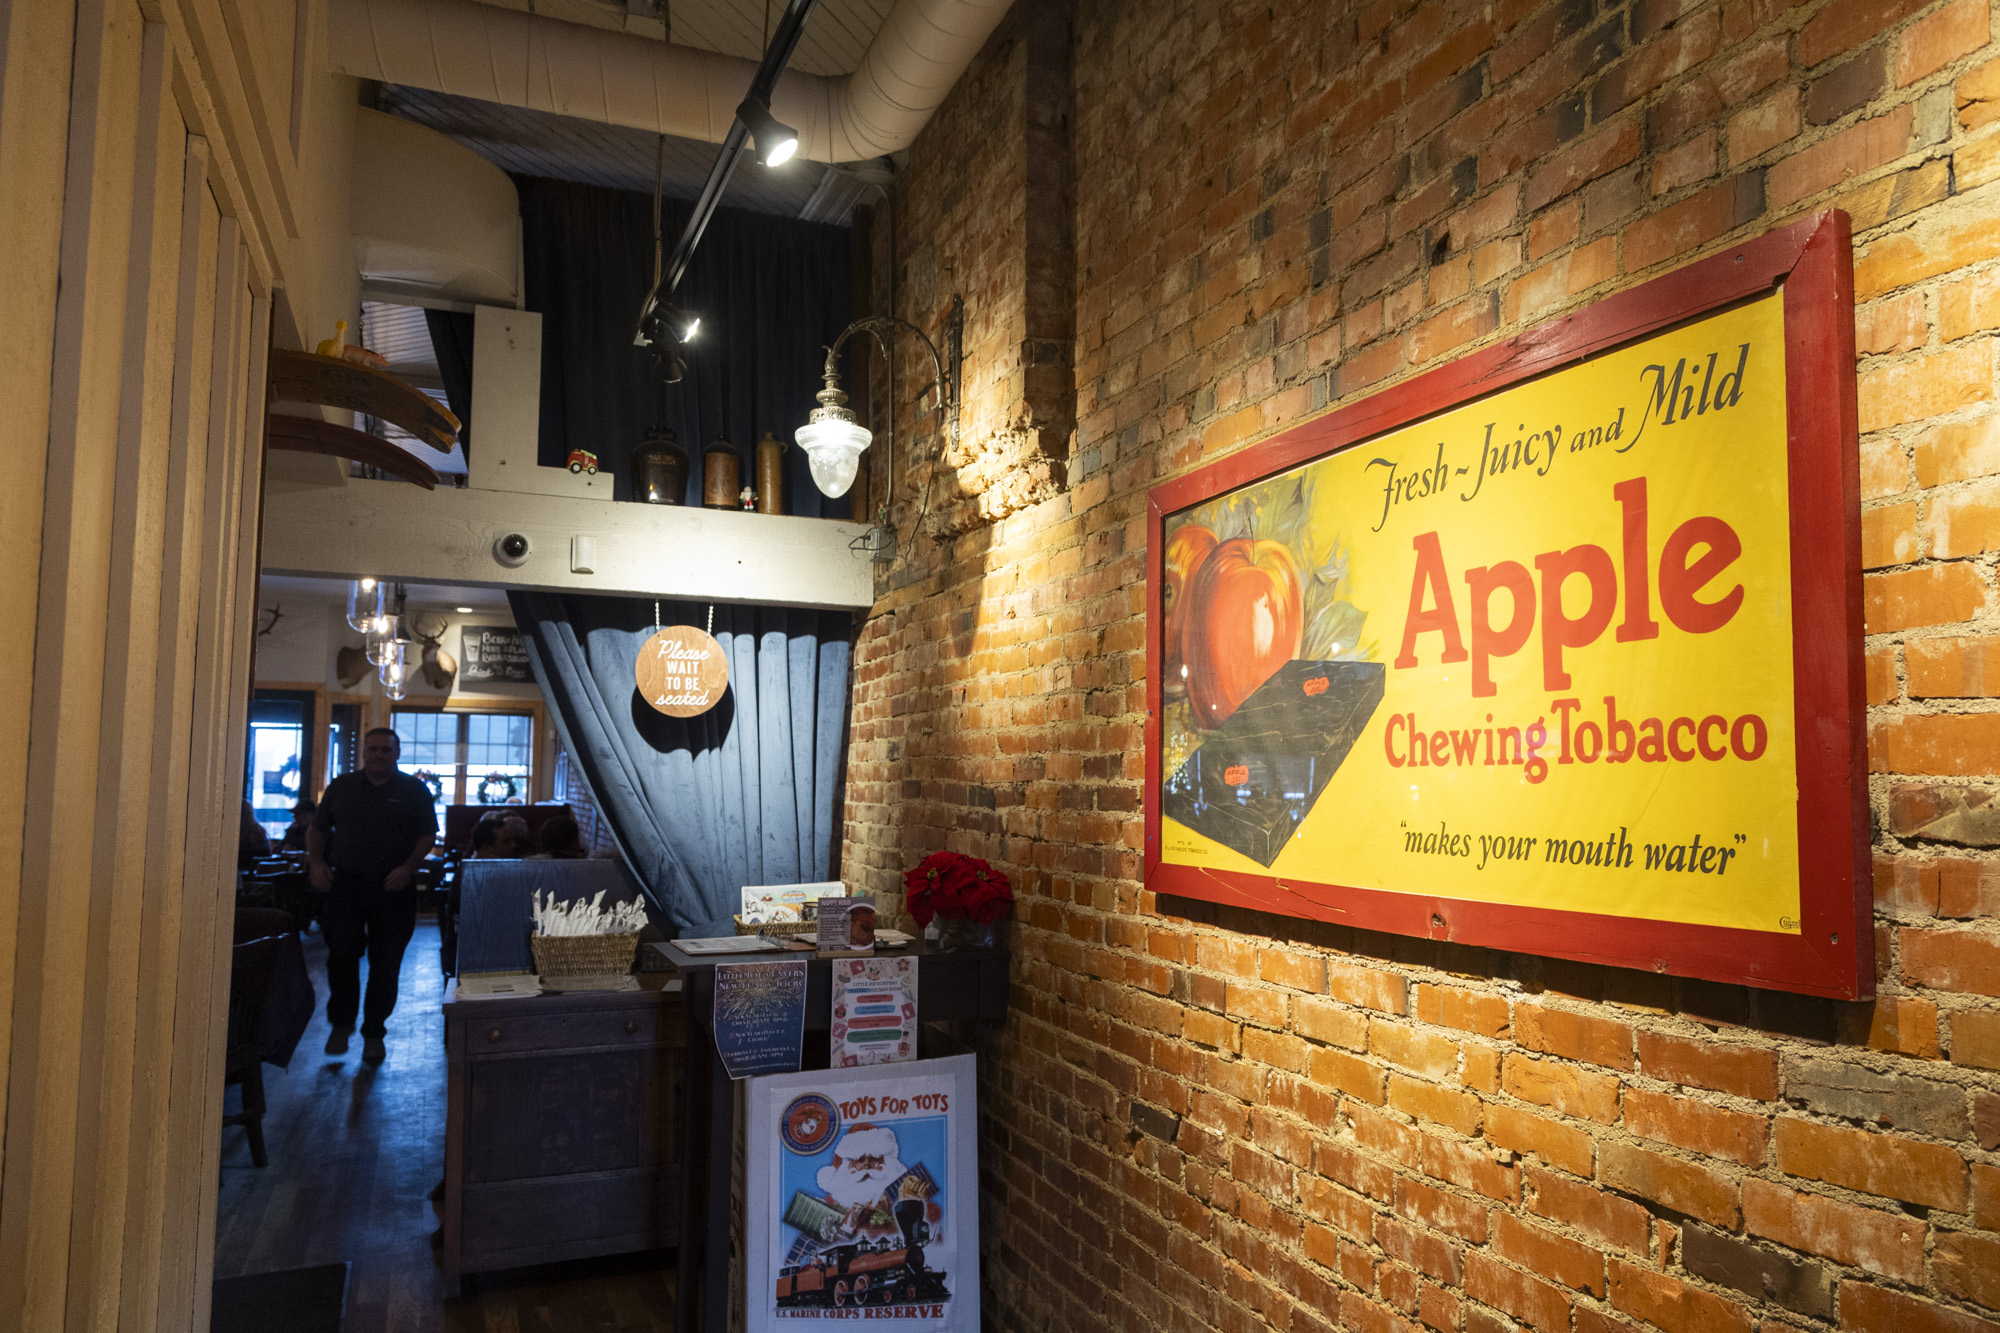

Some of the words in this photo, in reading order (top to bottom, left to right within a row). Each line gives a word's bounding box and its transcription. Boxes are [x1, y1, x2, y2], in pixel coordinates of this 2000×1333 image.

[1570, 408, 1624, 454] and
[1615, 342, 1750, 454] Mild
[1394, 476, 1745, 698] Apple
[657, 640, 711, 660] Please
[667, 661, 699, 675] WAIT
[666, 676, 681, 690] TO
[685, 677, 699, 691] BE
[655, 689, 709, 706] seated
[1384, 712, 1548, 784] Chewing
[1551, 696, 1768, 765] Tobacco
[1477, 835, 1538, 871] your
[1545, 827, 1634, 869] mouth
[720, 982, 737, 990] NEW
[839, 1096, 877, 1119] TOYS
[880, 1096, 908, 1114] FOR
[911, 1093, 949, 1112] TOTS
[775, 1309, 789, 1319] U.S.
[790, 1309, 821, 1319] MARINE
[823, 1308, 860, 1319] CORPS
[863, 1304, 944, 1319] RESERVE
